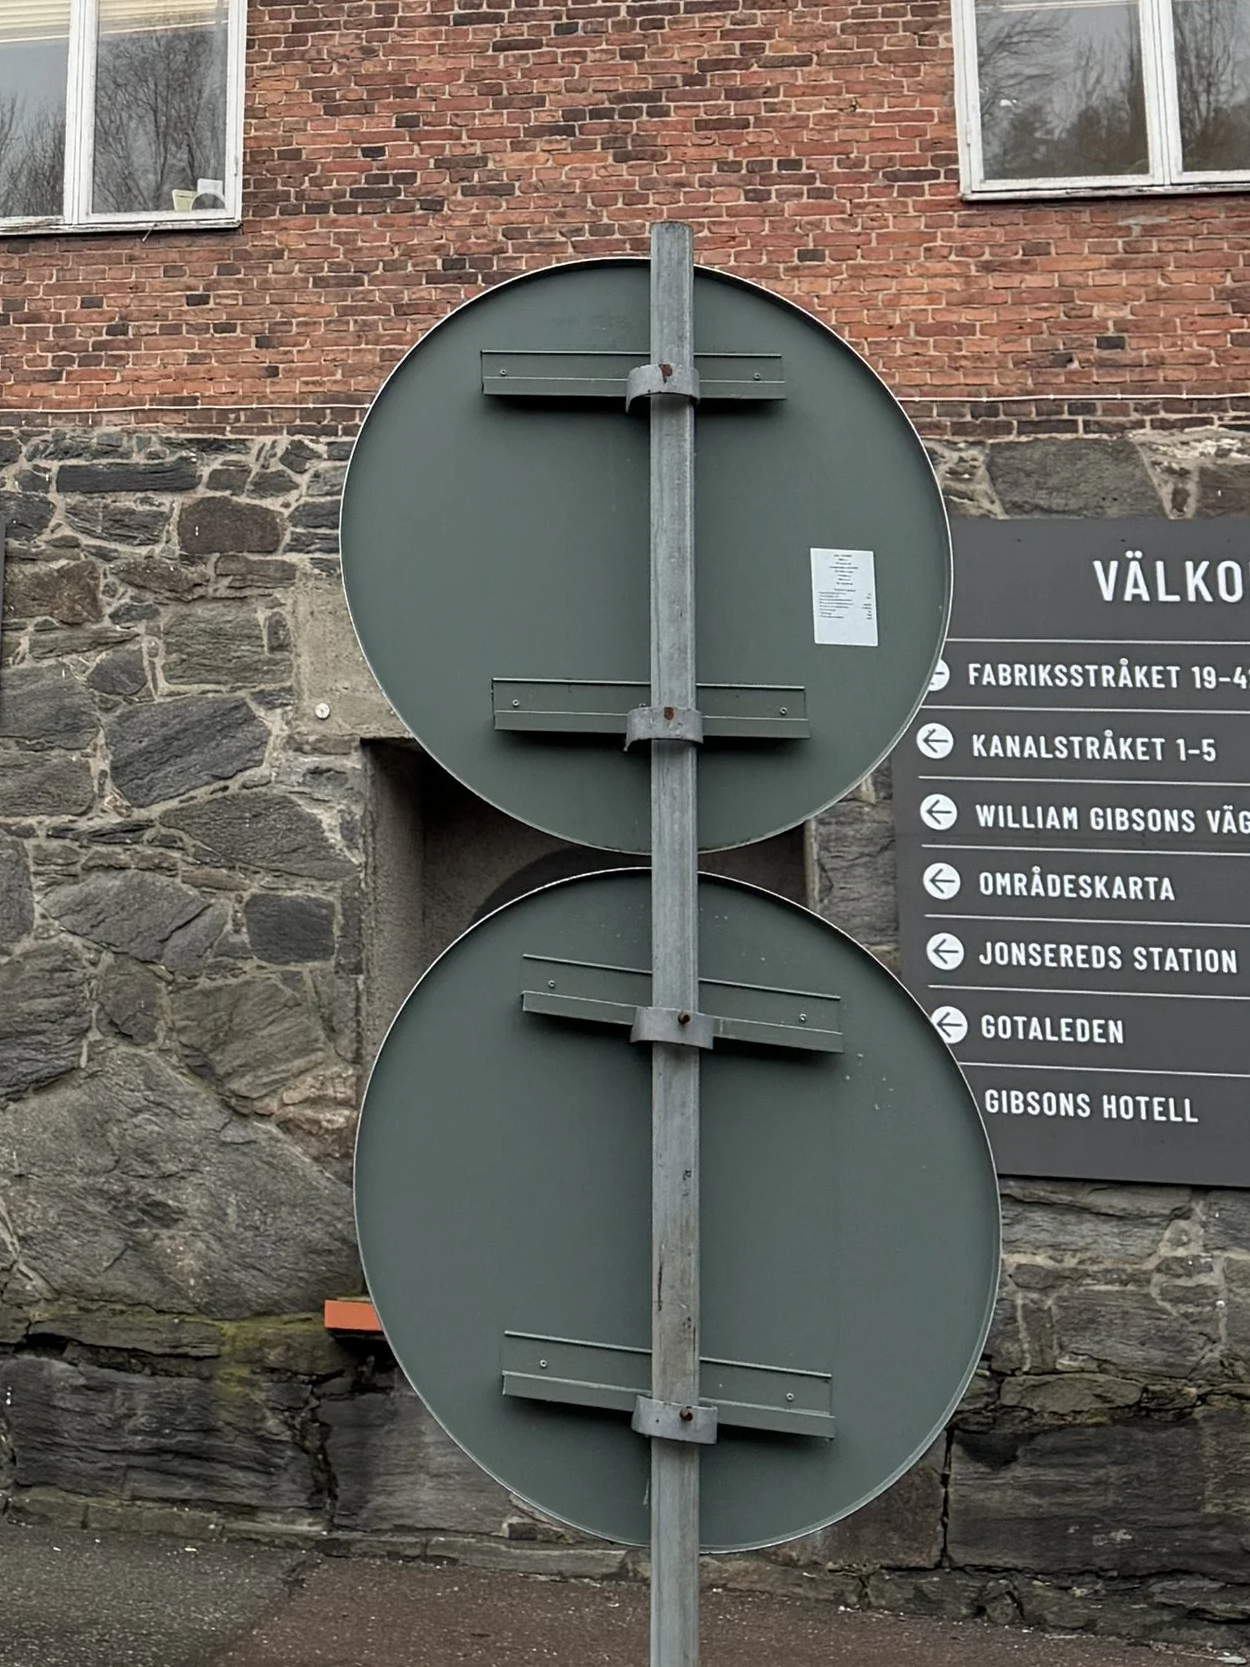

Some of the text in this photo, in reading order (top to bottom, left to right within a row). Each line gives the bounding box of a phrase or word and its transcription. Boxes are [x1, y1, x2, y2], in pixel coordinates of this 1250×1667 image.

[1092, 550, 1250, 603] VÄLKO
[968, 657, 1250, 690] FABRIKSSTRÅKET 19-4
[972, 729, 1216, 762] KANALSTRÅKET 1-5
[975, 804, 1250, 834] WILLIAM GIBSONS VÄG
[979, 865, 1175, 901] OMRÅDESKARTA
[978, 941, 1237, 974] JONSEREDS STATION
[981, 1014, 1124, 1044] GOTALEDEN
[984, 1089, 1199, 1123] GIBSONS HOTELL
